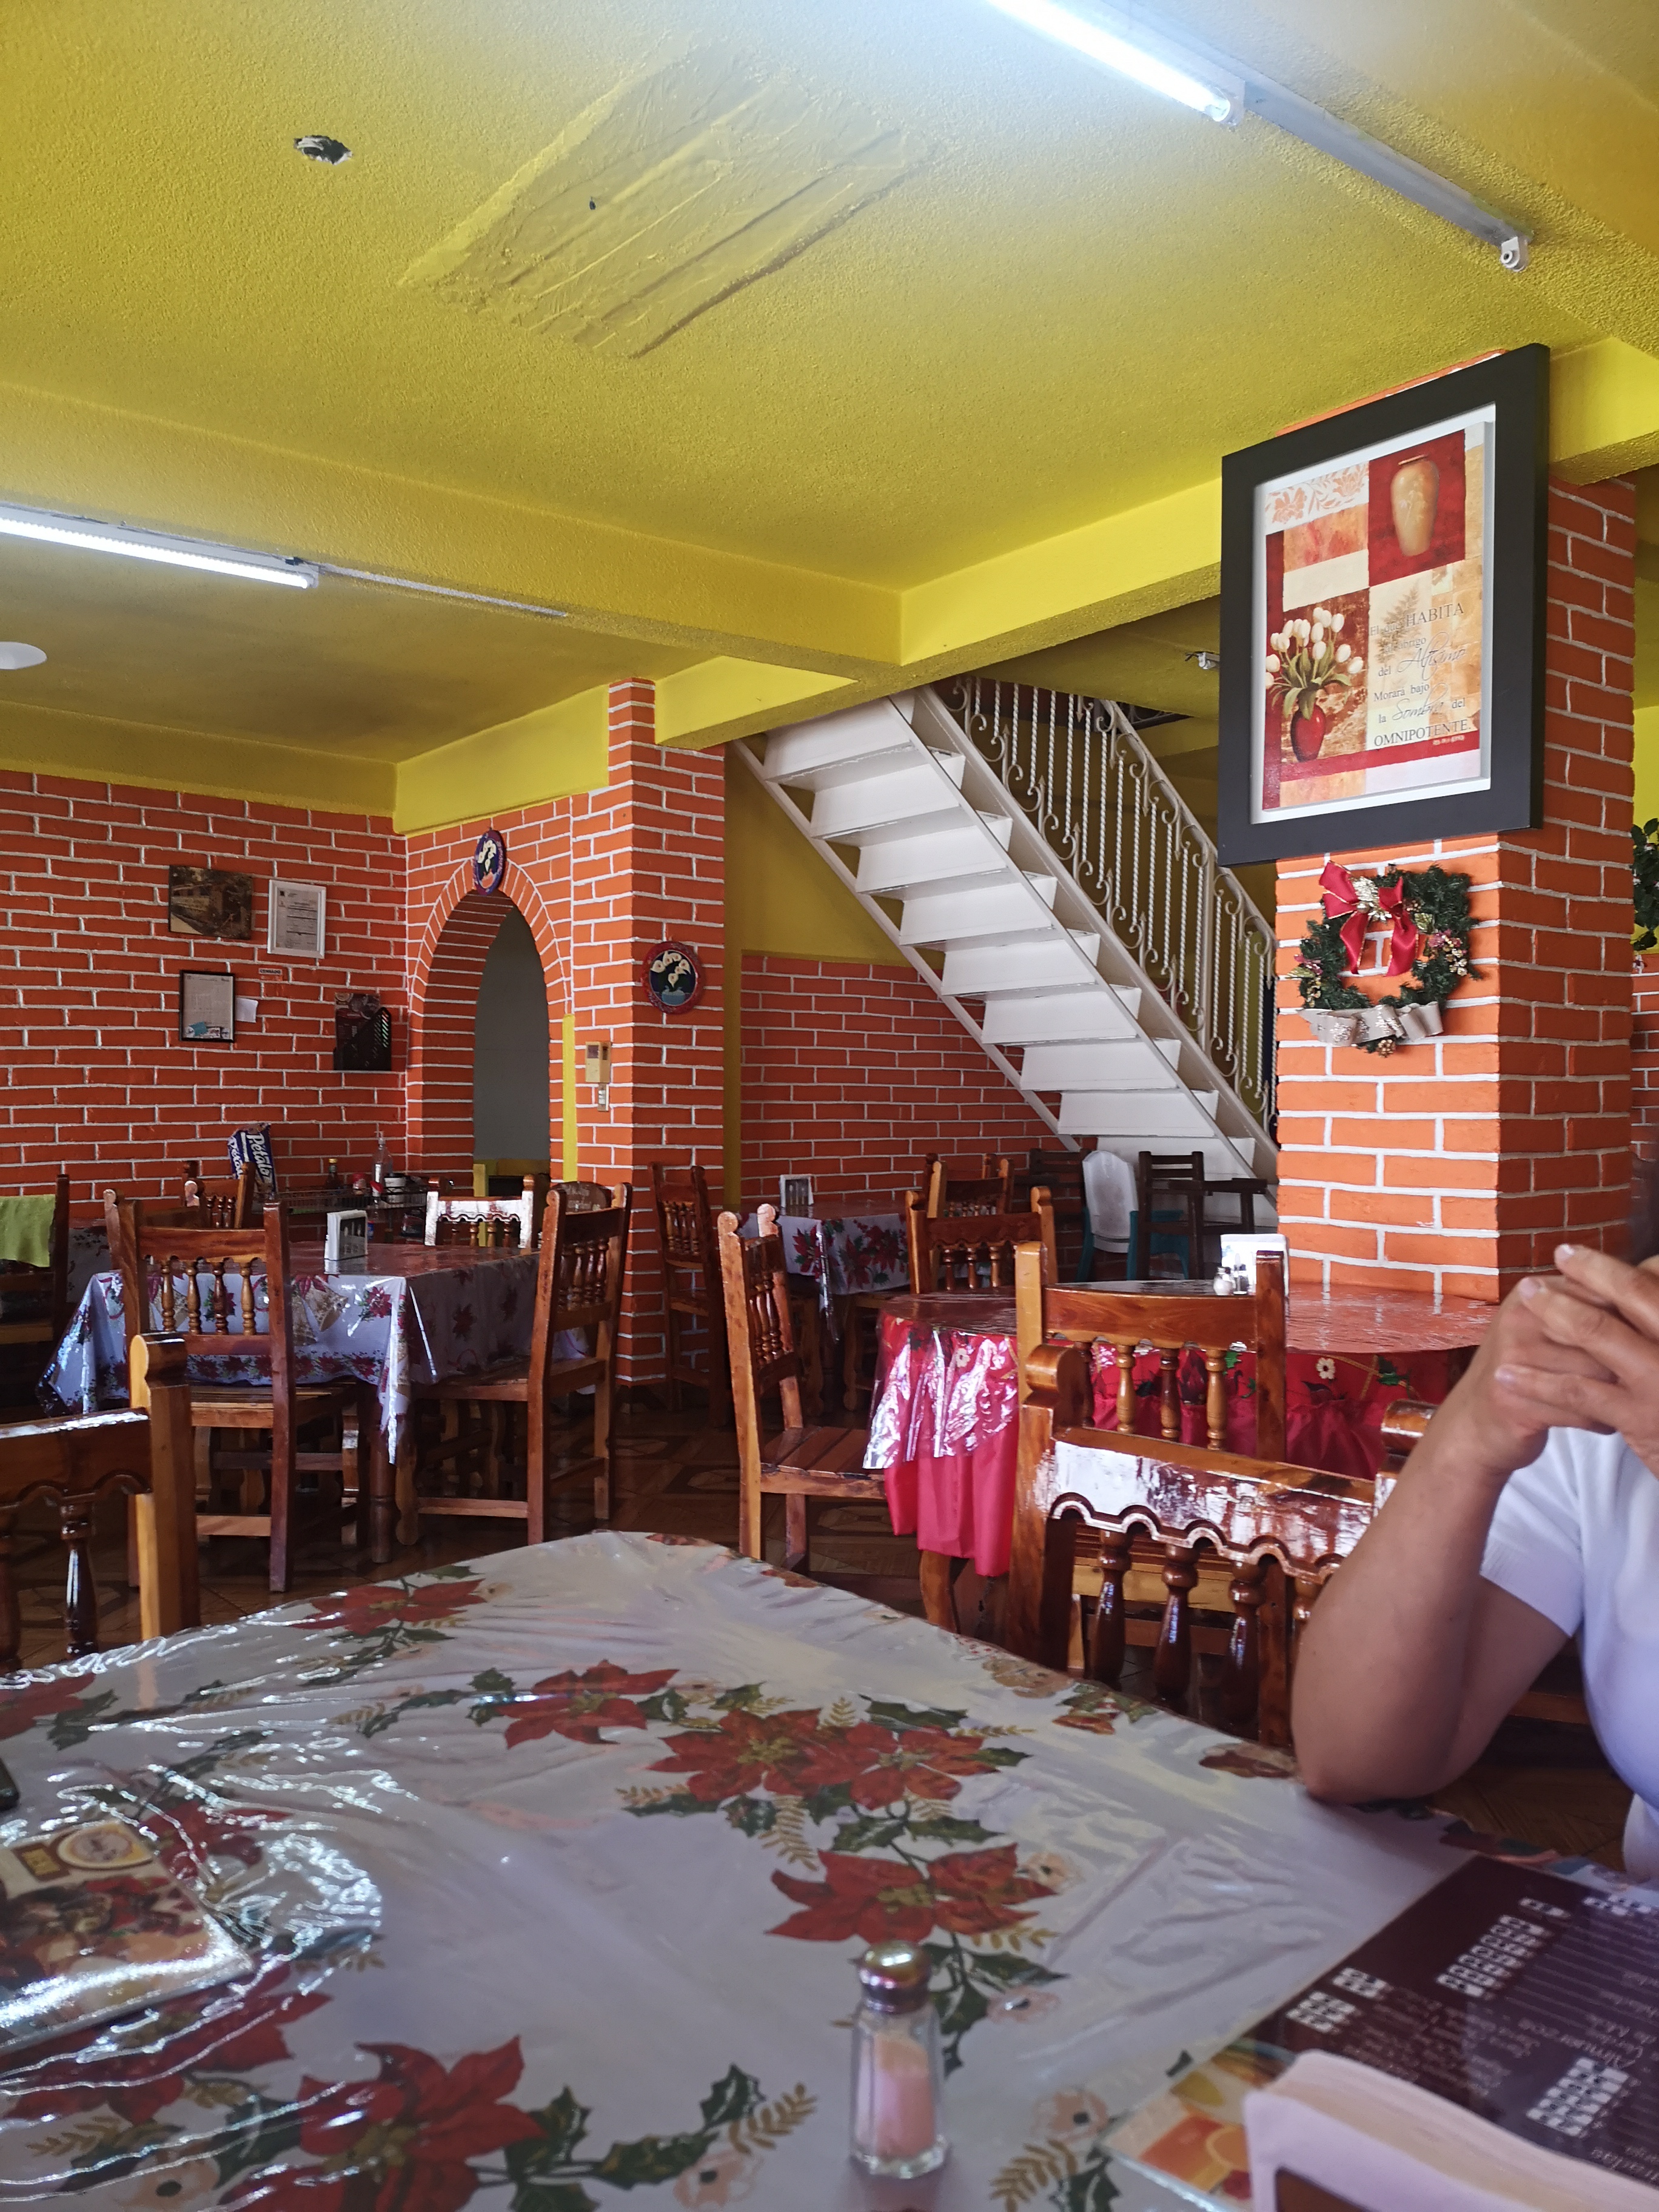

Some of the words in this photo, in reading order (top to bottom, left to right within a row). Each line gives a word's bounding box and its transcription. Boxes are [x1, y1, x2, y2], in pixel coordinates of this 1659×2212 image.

[1370, 626, 1379, 636] El
[1406, 603, 1464, 628] HABITA
[1398, 637, 1427, 650] abrigo
[1378, 666, 1392, 677] del
[1373, 686, 1406, 702] Morará
[1410, 683, 1430, 695] bajo
[1378, 714, 1387, 723] la
[1392, 682, 1449, 720] Sombra
[1452, 699, 1466, 709] del
[1373, 719, 1471, 746] OMNIPOTENTE.
